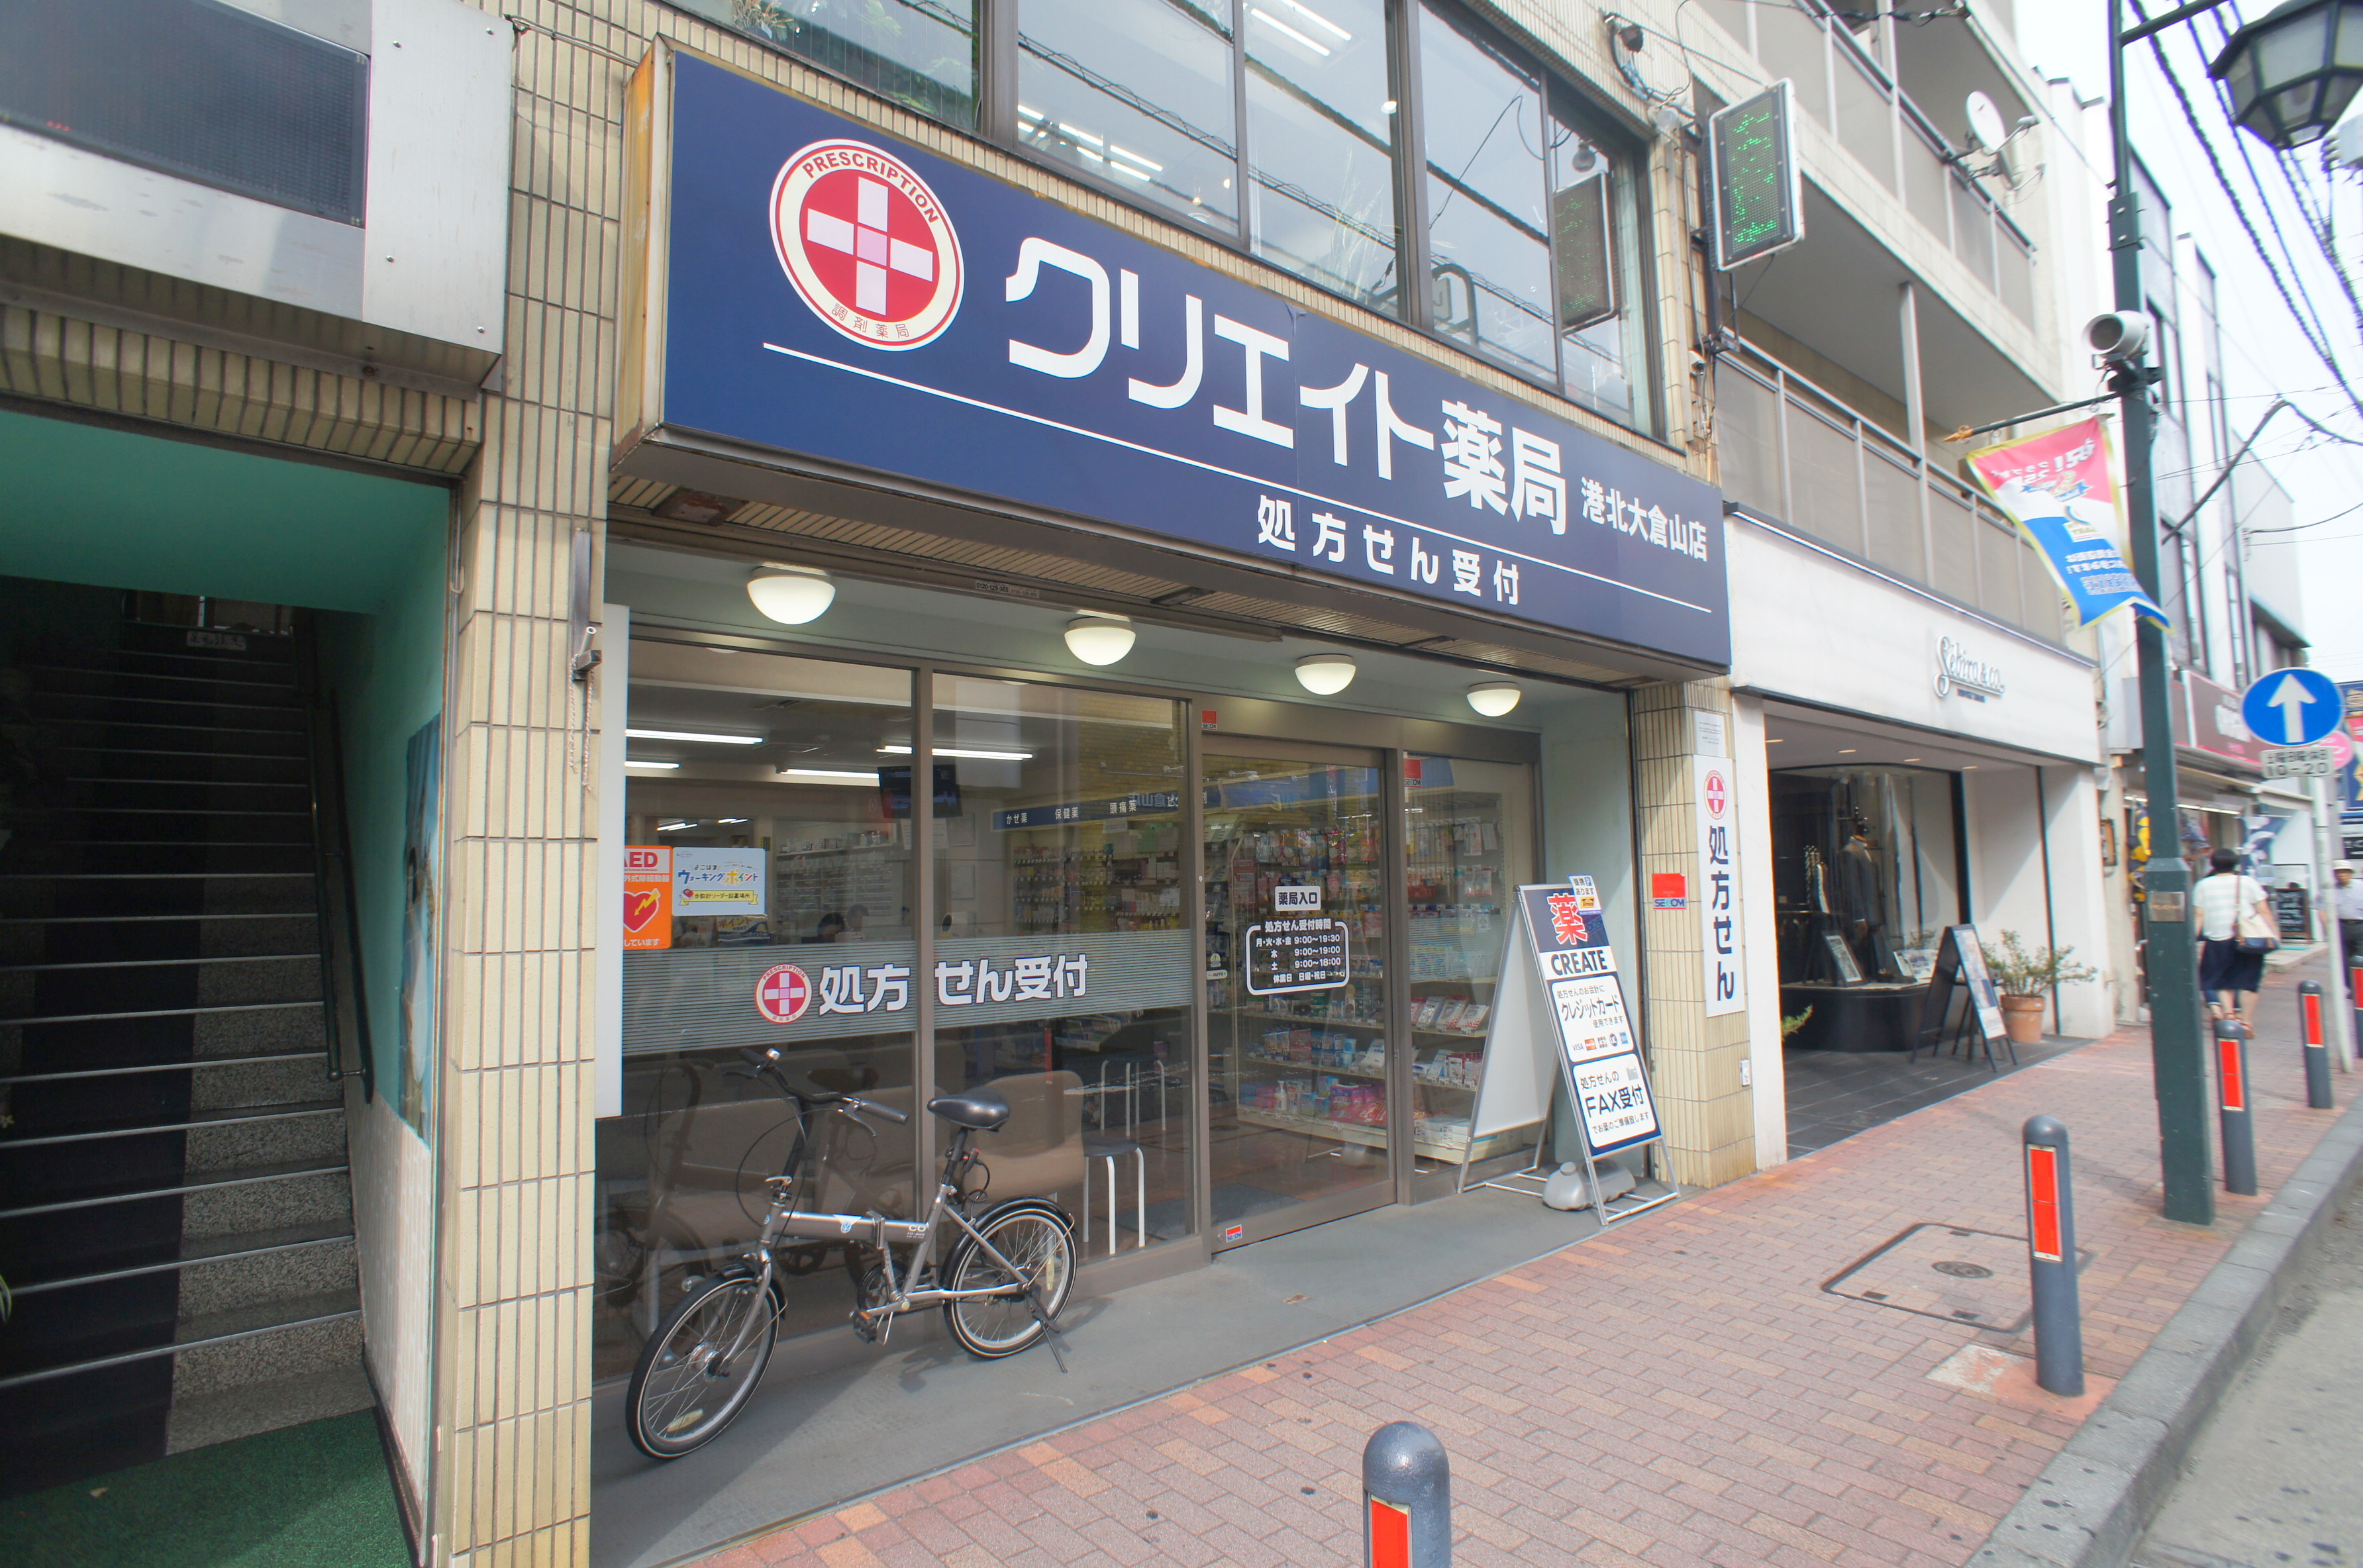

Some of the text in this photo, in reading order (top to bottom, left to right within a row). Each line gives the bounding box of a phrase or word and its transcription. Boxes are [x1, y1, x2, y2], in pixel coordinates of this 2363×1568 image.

[803, 151, 939, 224] PRESCRIPTION
[831, 303, 910, 339] 調剤薬局
[1005, 236, 1567, 536] クリエイト薬局
[1580, 476, 1708, 562] 港北大倉山店
[1257, 495, 1521, 605] 処方せん受付
[2267, 762, 2329, 777] 10-20
[1054, 807, 1078, 820] 保健薬
[1109, 800, 1136, 814] 頭痛薬
[1006, 812, 1027, 824] かぜ薬
[678, 868, 759, 885] ウォーキングポイント
[1278, 892, 1317, 905] 薬局入口
[1547, 893, 1588, 945] 薬
[1709, 825, 1733, 1000] 処方せん
[1265, 918, 1331, 933] 処方せん受付時間
[1271, 950, 1278, 958] 木
[1272, 962, 1278, 971] 土
[1550, 950, 1608, 976] CREATE
[763, 965, 806, 980] PRESCRIPTION
[1273, 973, 1292, 983] 休業日
[1562, 995, 1619, 1022] クレジットカード
[1580, 1071, 1619, 1090] 処方せんの
[1585, 1084, 1644, 1118] FAX受付
